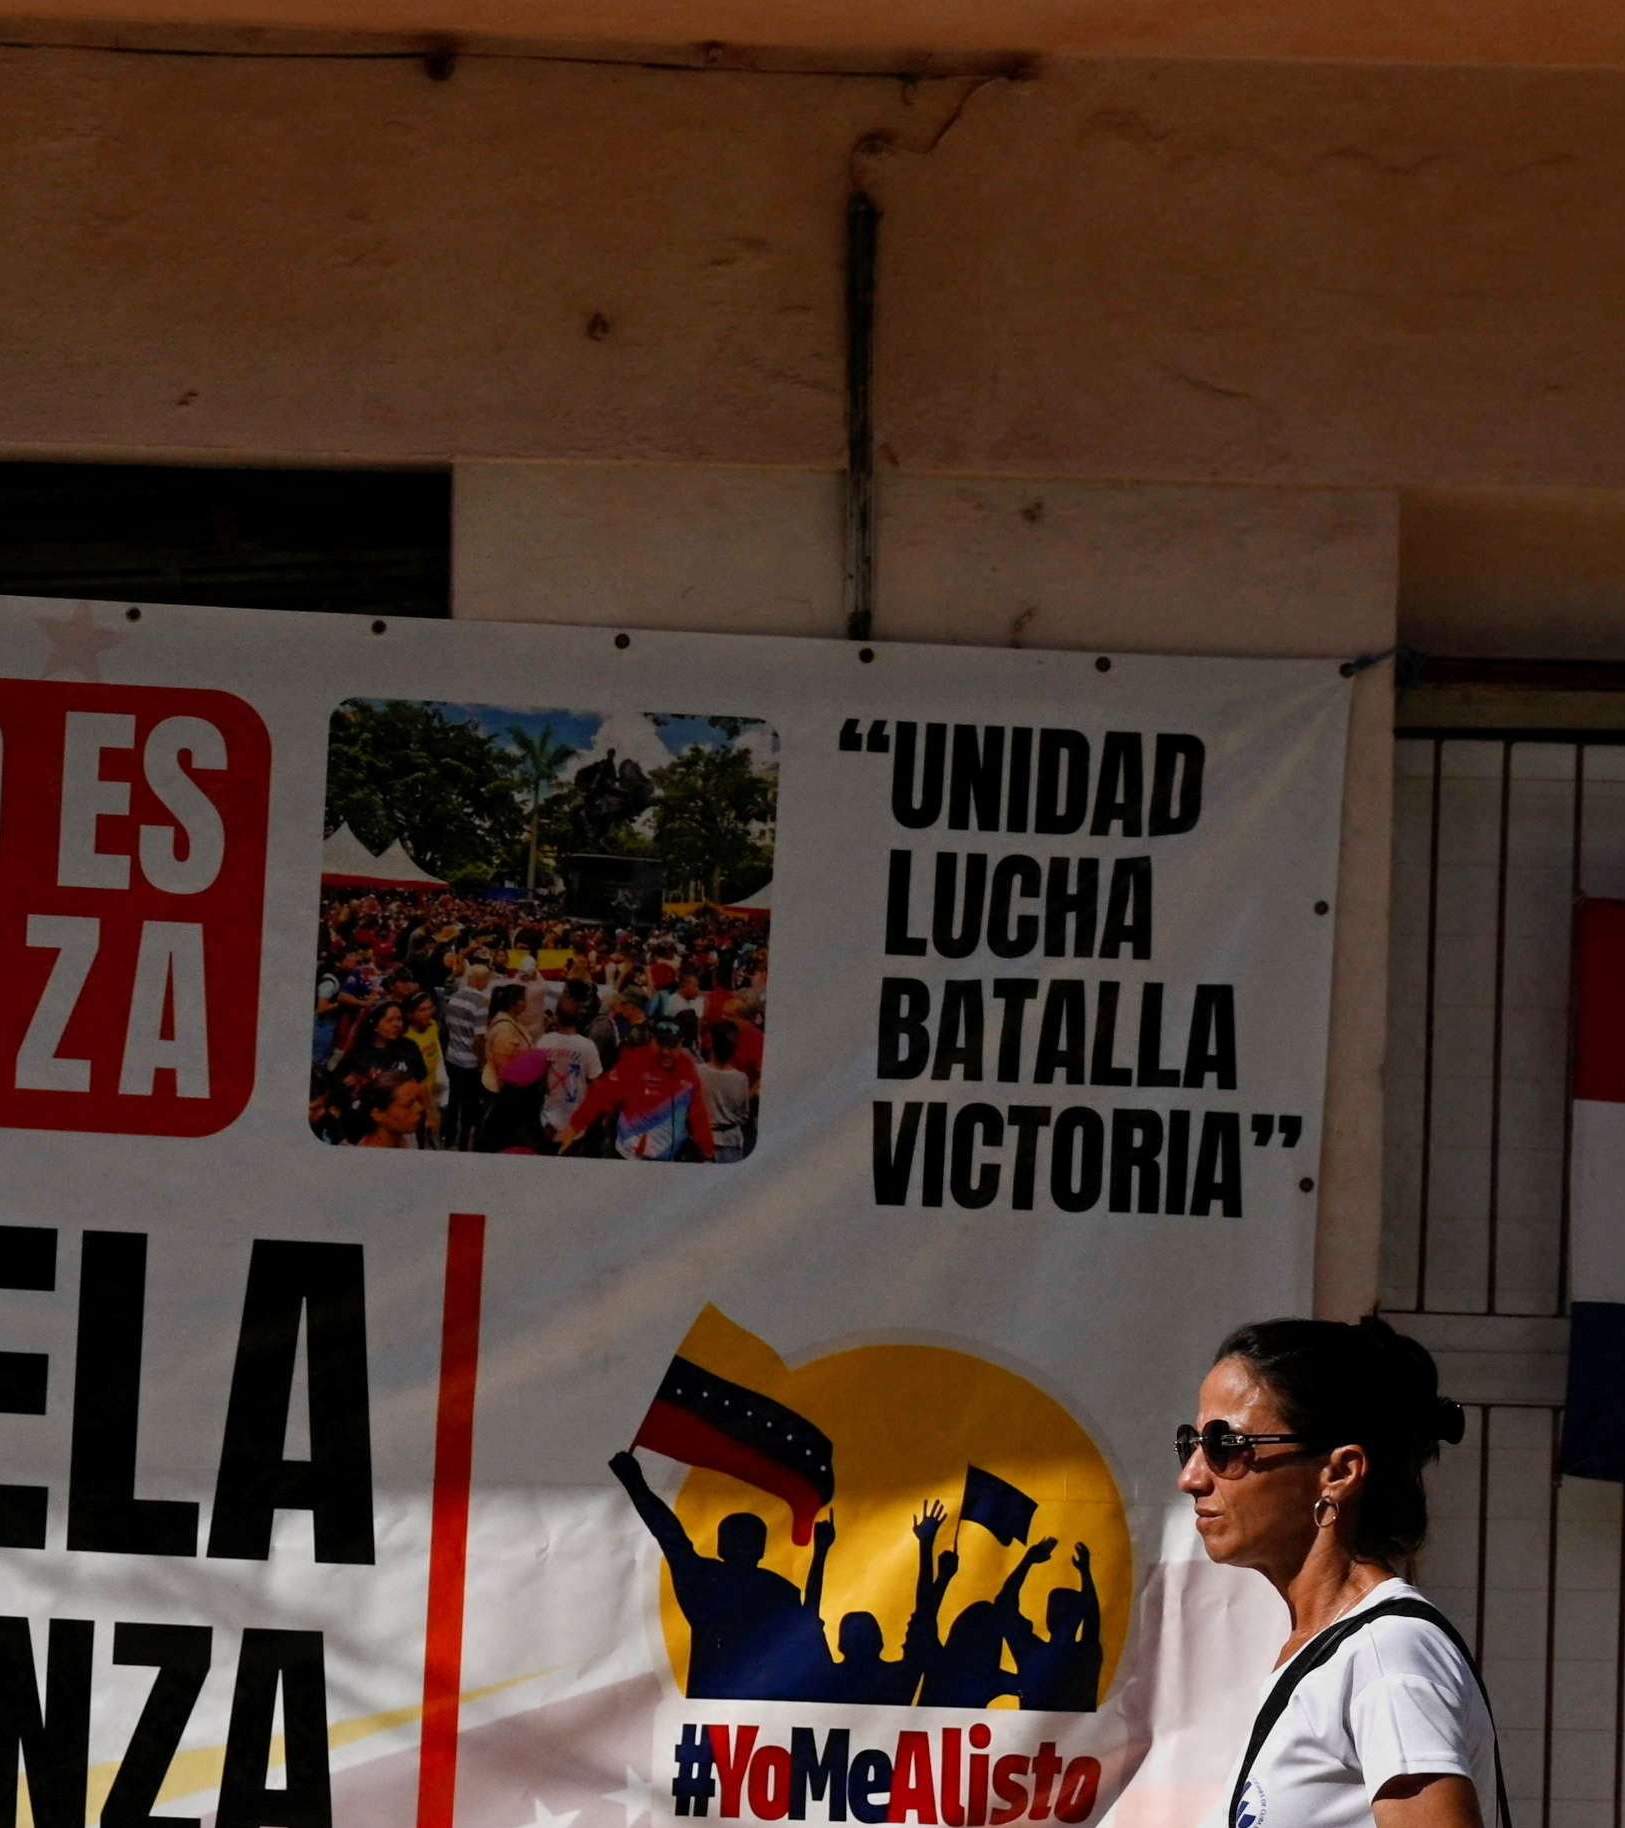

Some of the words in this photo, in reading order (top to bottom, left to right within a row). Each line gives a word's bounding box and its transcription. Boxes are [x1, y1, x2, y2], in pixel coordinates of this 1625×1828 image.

[58, 710, 229, 896] ES
[839, 719, 1204, 836] “UNIDAD
[885, 850, 1152, 961] LUCHA
[877, 978, 1237, 1090] BATALLA
[873, 1101, 1302, 1218] VICTORIA”
[672, 1723, 1101, 1827] #YoMeAlisto
